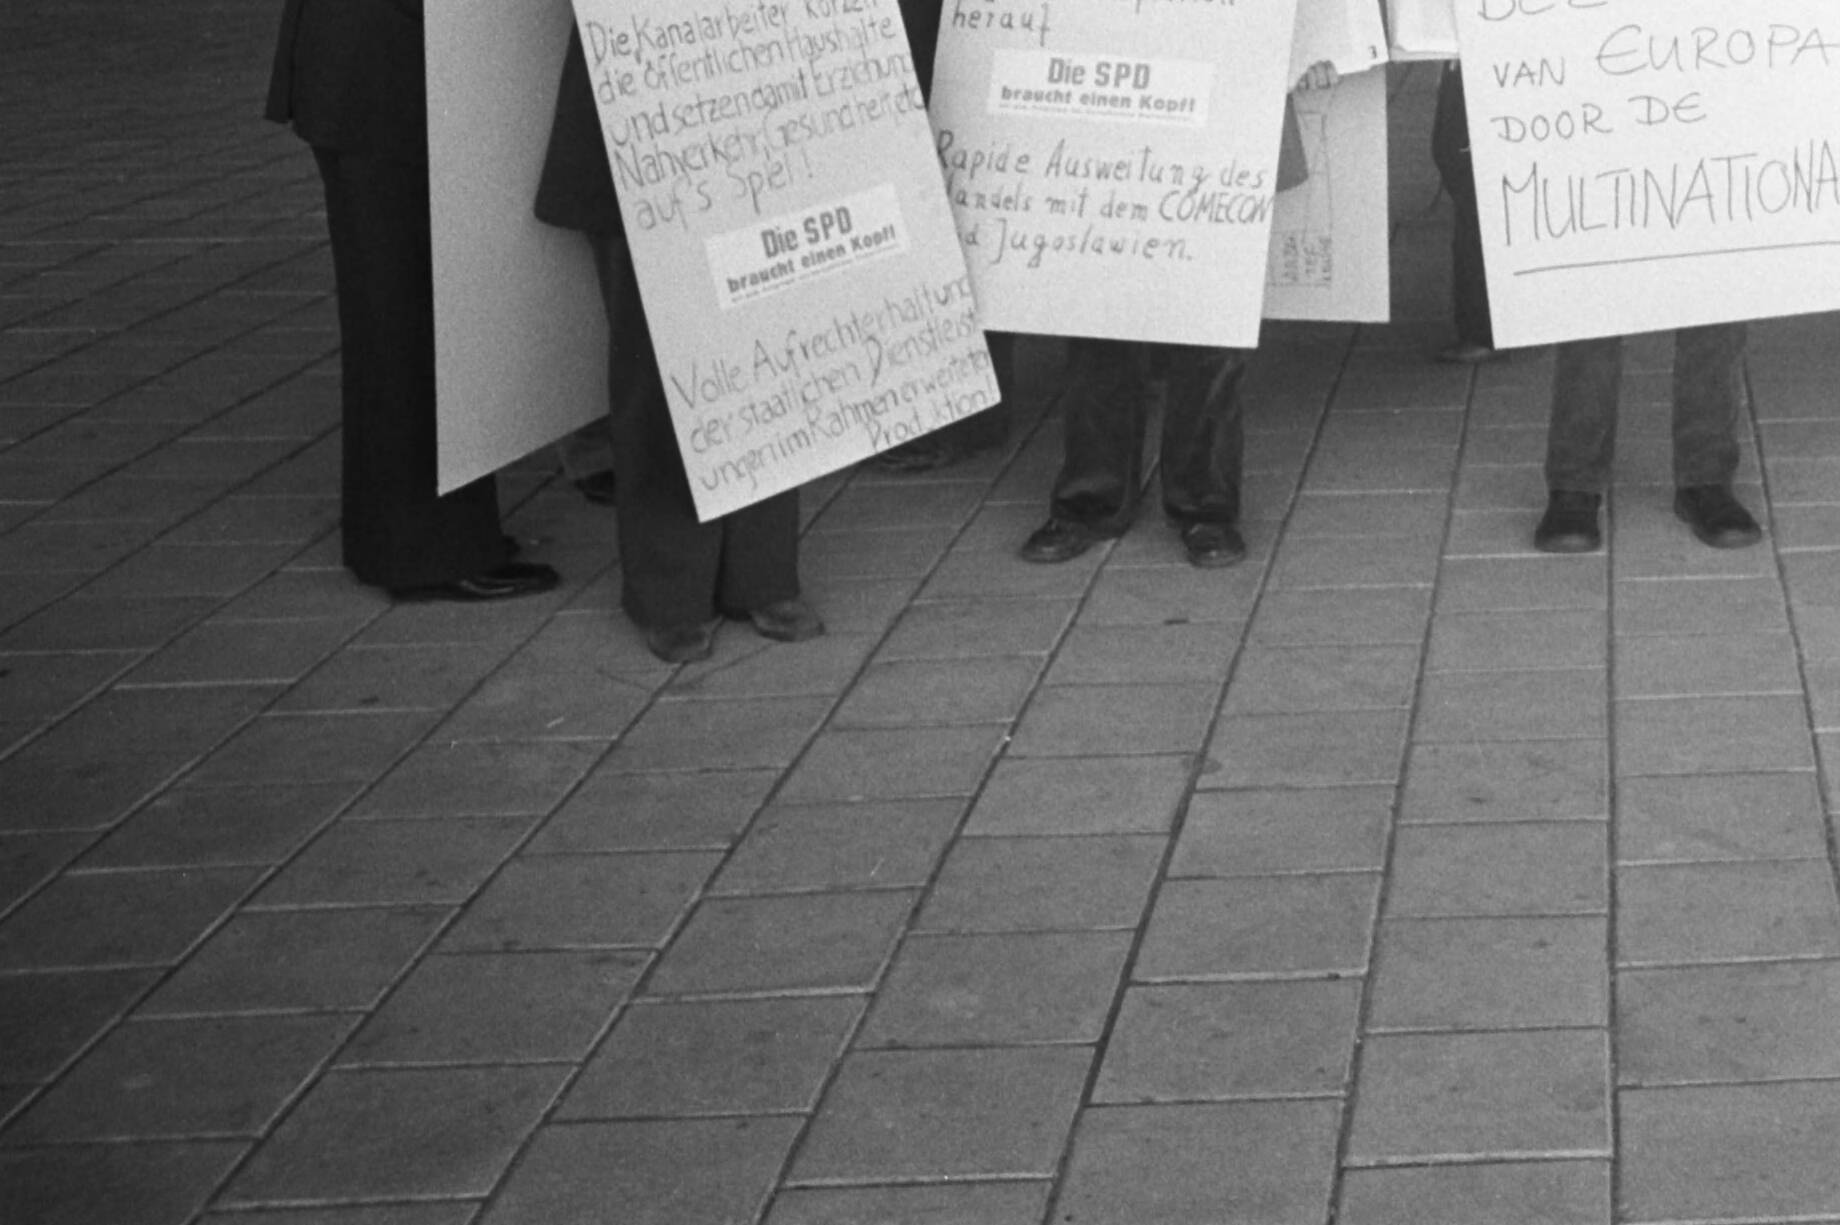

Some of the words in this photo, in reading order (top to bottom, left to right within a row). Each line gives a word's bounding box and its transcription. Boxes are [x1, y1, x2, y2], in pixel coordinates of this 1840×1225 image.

[588, 20, 631, 67] Die
[952, 1, 1051, 47] herauf
[599, 65, 637, 105] die
[1048, 57, 1086, 86] Die
[1095, 60, 1151, 91] SPD
[1493, 57, 1565, 88] VAN
[1001, 85, 1072, 105] braucht
[1079, 90, 1131, 109] einen
[1490, 103, 1613, 143] DOOR
[1628, 92, 1707, 126] DE
[937, 129, 1031, 180] Rapide
[1045, 137, 1211, 195] Ausweitung
[1220, 160, 1266, 188] des
[1045, 190, 1087, 218] mit
[1100, 188, 1148, 220] dem
[1159, 189, 1274, 224] COMECON
[761, 226, 798, 259] Die
[803, 205, 852, 246] SPD
[726, 259, 795, 294] braucht
[801, 243, 846, 269] einen
[671, 358, 742, 411] Volle
[690, 411, 732, 455] der
